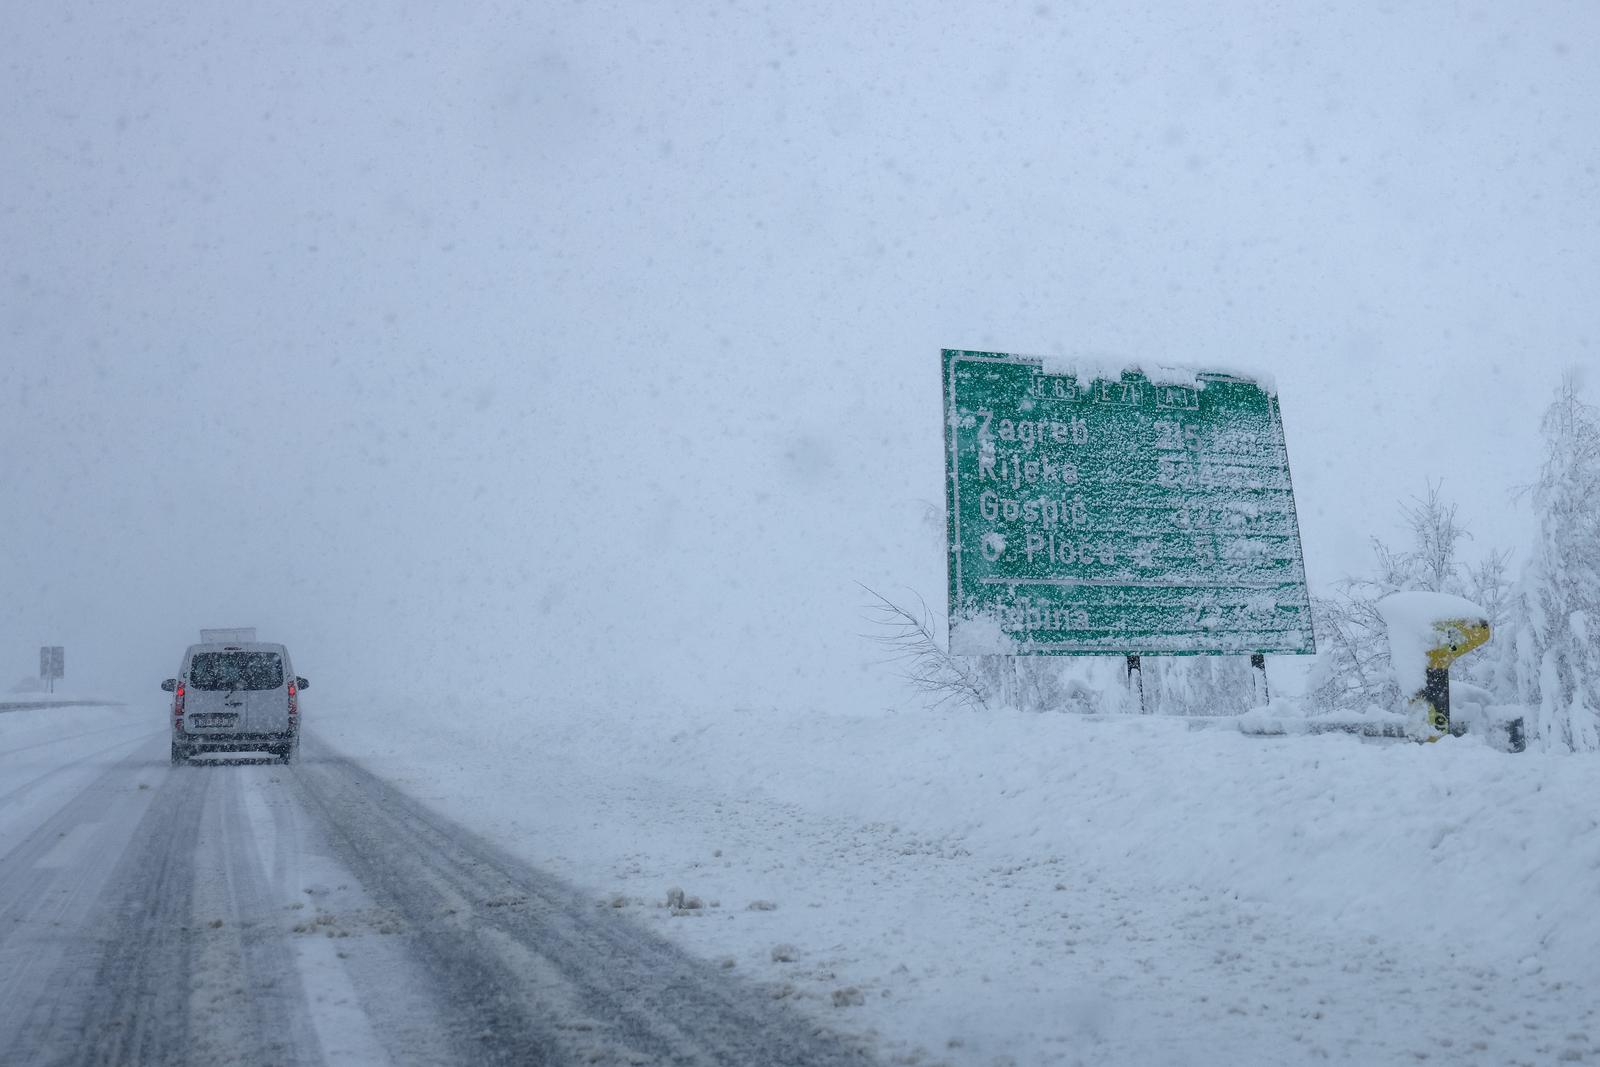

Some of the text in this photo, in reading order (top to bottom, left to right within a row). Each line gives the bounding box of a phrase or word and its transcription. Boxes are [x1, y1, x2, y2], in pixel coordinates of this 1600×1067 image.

[1036, 376, 1076, 399] E 65
[976, 410, 1088, 450] Zagreb
[978, 442, 1078, 489] Rijeka
